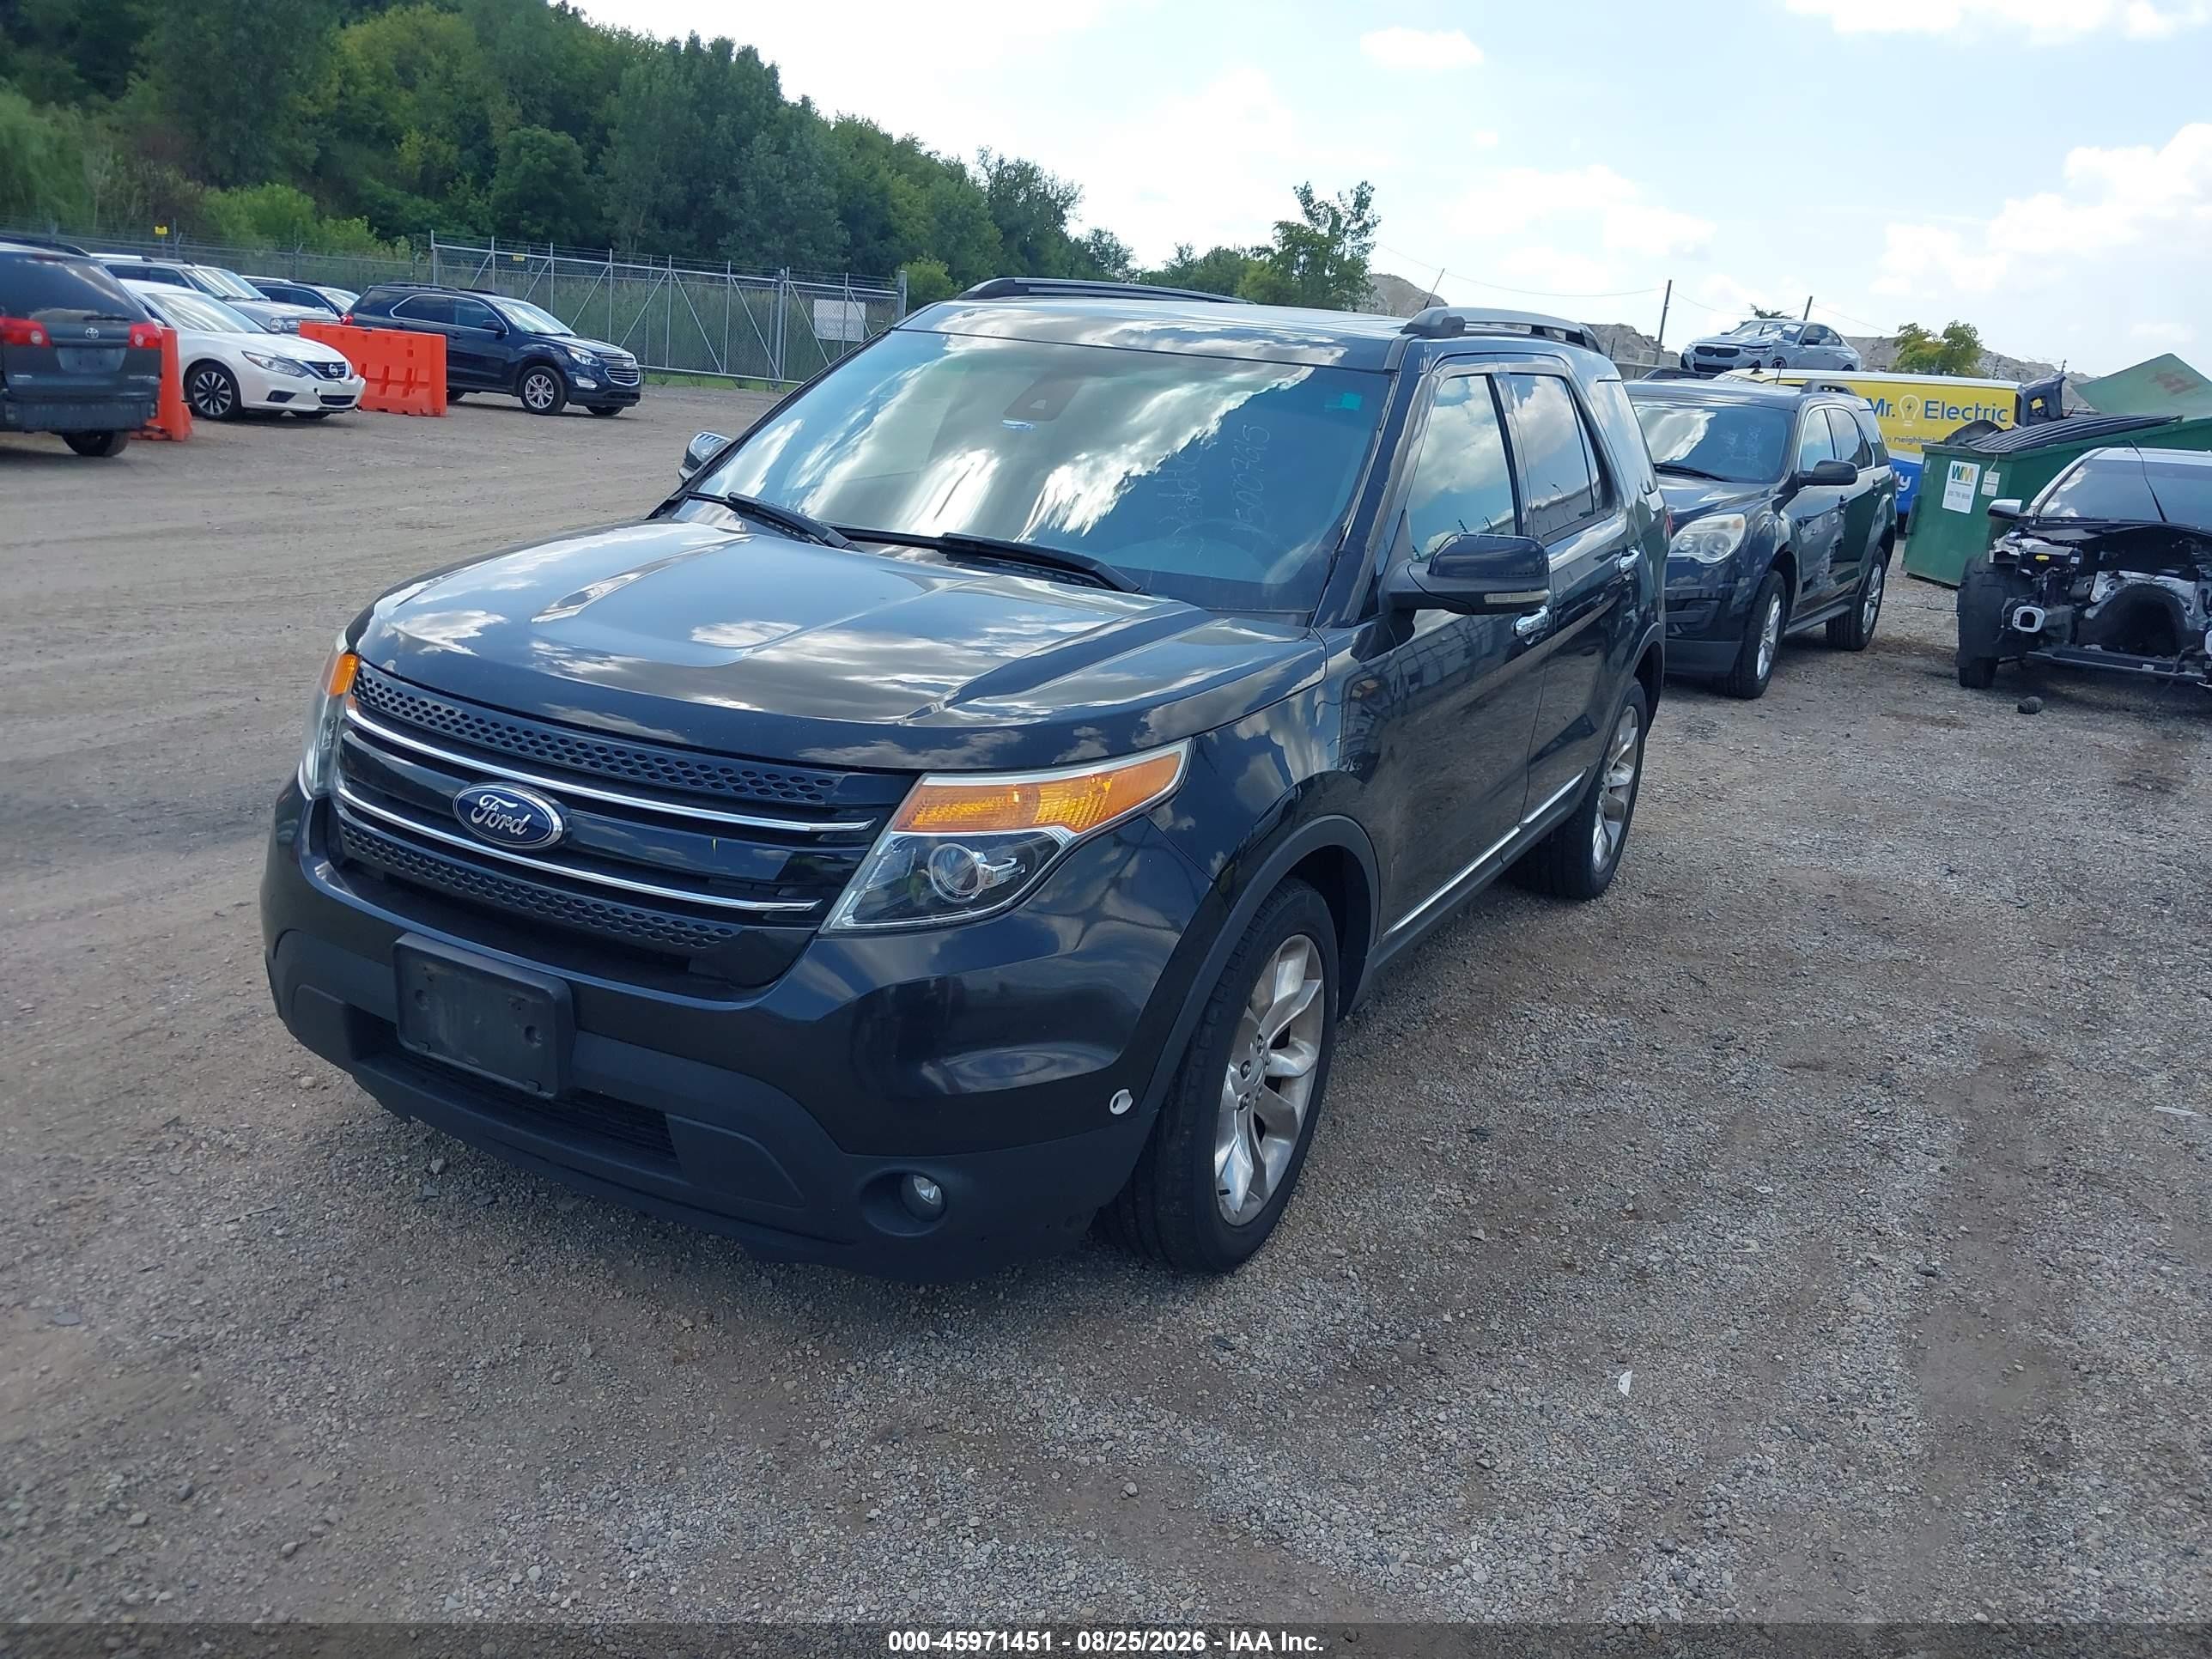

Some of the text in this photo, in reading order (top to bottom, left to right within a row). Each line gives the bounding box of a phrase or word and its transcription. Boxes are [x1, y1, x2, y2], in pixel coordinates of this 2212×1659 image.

[1865, 398, 2008, 422] Mr. Electric
[1951, 465, 1974, 483] WM
[470, 794, 532, 836] Ford
